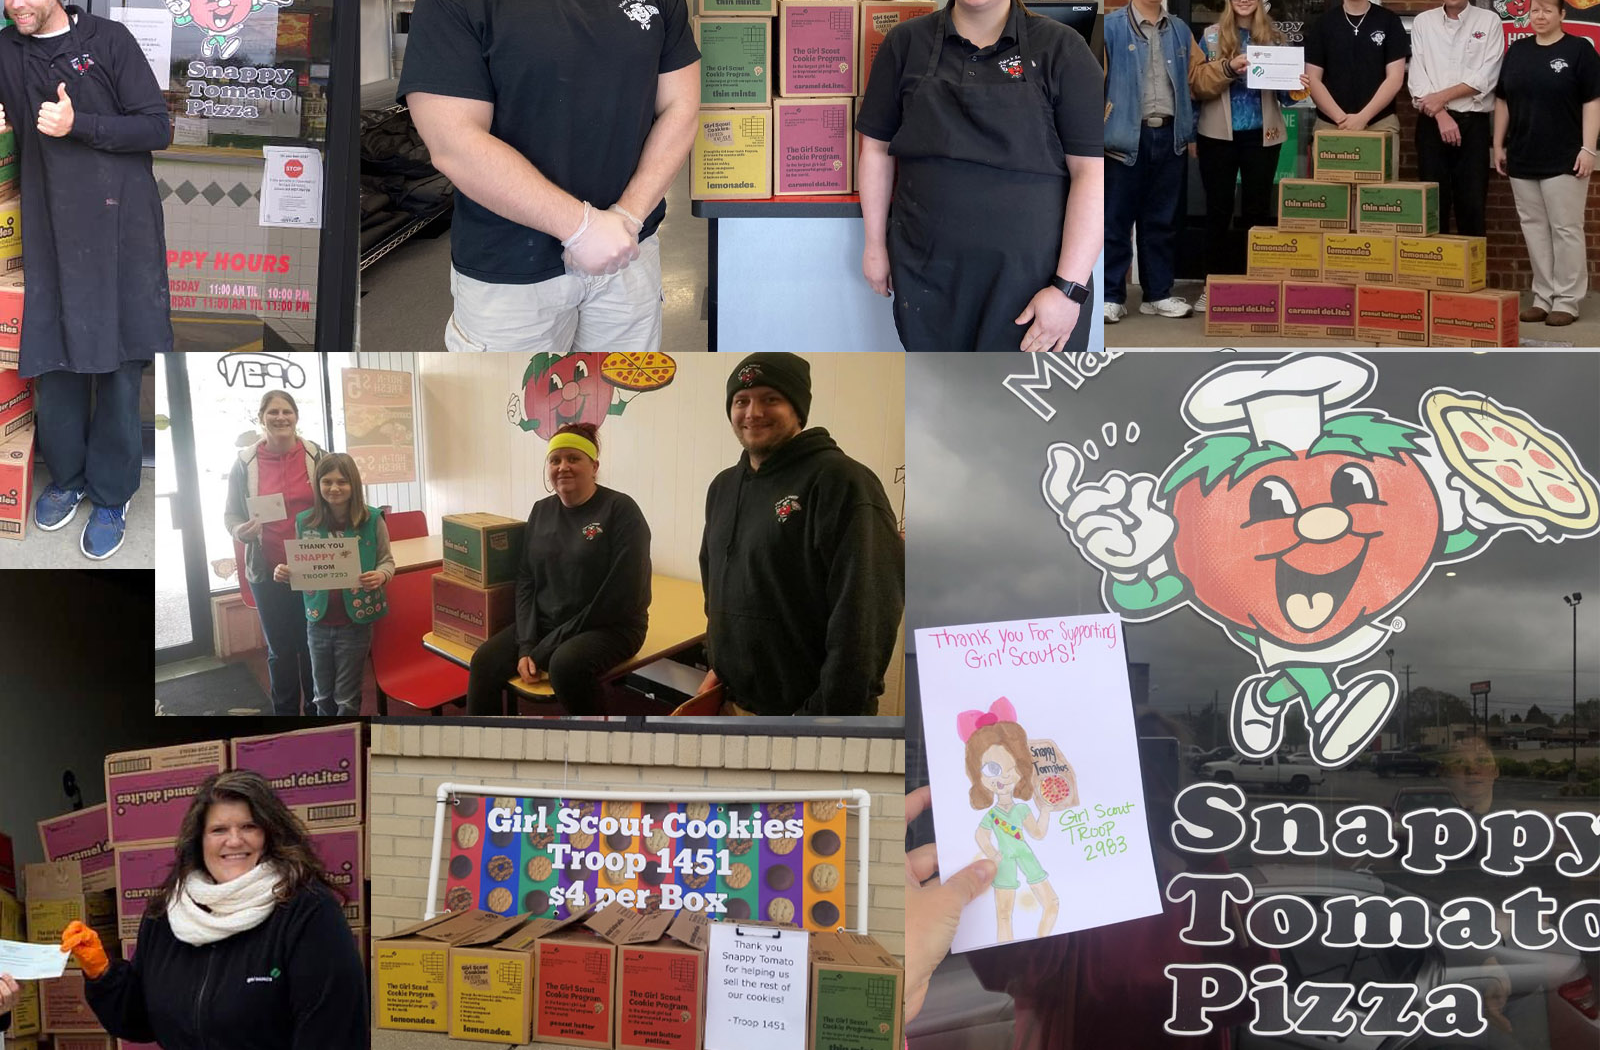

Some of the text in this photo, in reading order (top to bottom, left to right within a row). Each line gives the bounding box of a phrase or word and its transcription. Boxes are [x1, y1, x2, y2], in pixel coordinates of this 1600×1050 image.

[188, 61, 292, 83] Snappy
[187, 81, 292, 101] Tomato
[186, 98, 260, 120] Pizza
[214, 252, 291, 273] HOURS
[294, 553, 335, 562] SNAPPY
[928, 621, 1117, 651] Thank you For Supporting
[965, 643, 1075, 668] Girl Scouts!
[487, 806, 804, 841] Girl Scout Cookies
[1058, 801, 1135, 826] Girl Scout
[1083, 836, 1128, 861] 2983
[547, 844, 733, 879] Troop 1451
[549, 882, 728, 914] $4 per Box
[1163, 963, 1488, 1037] Pizza
